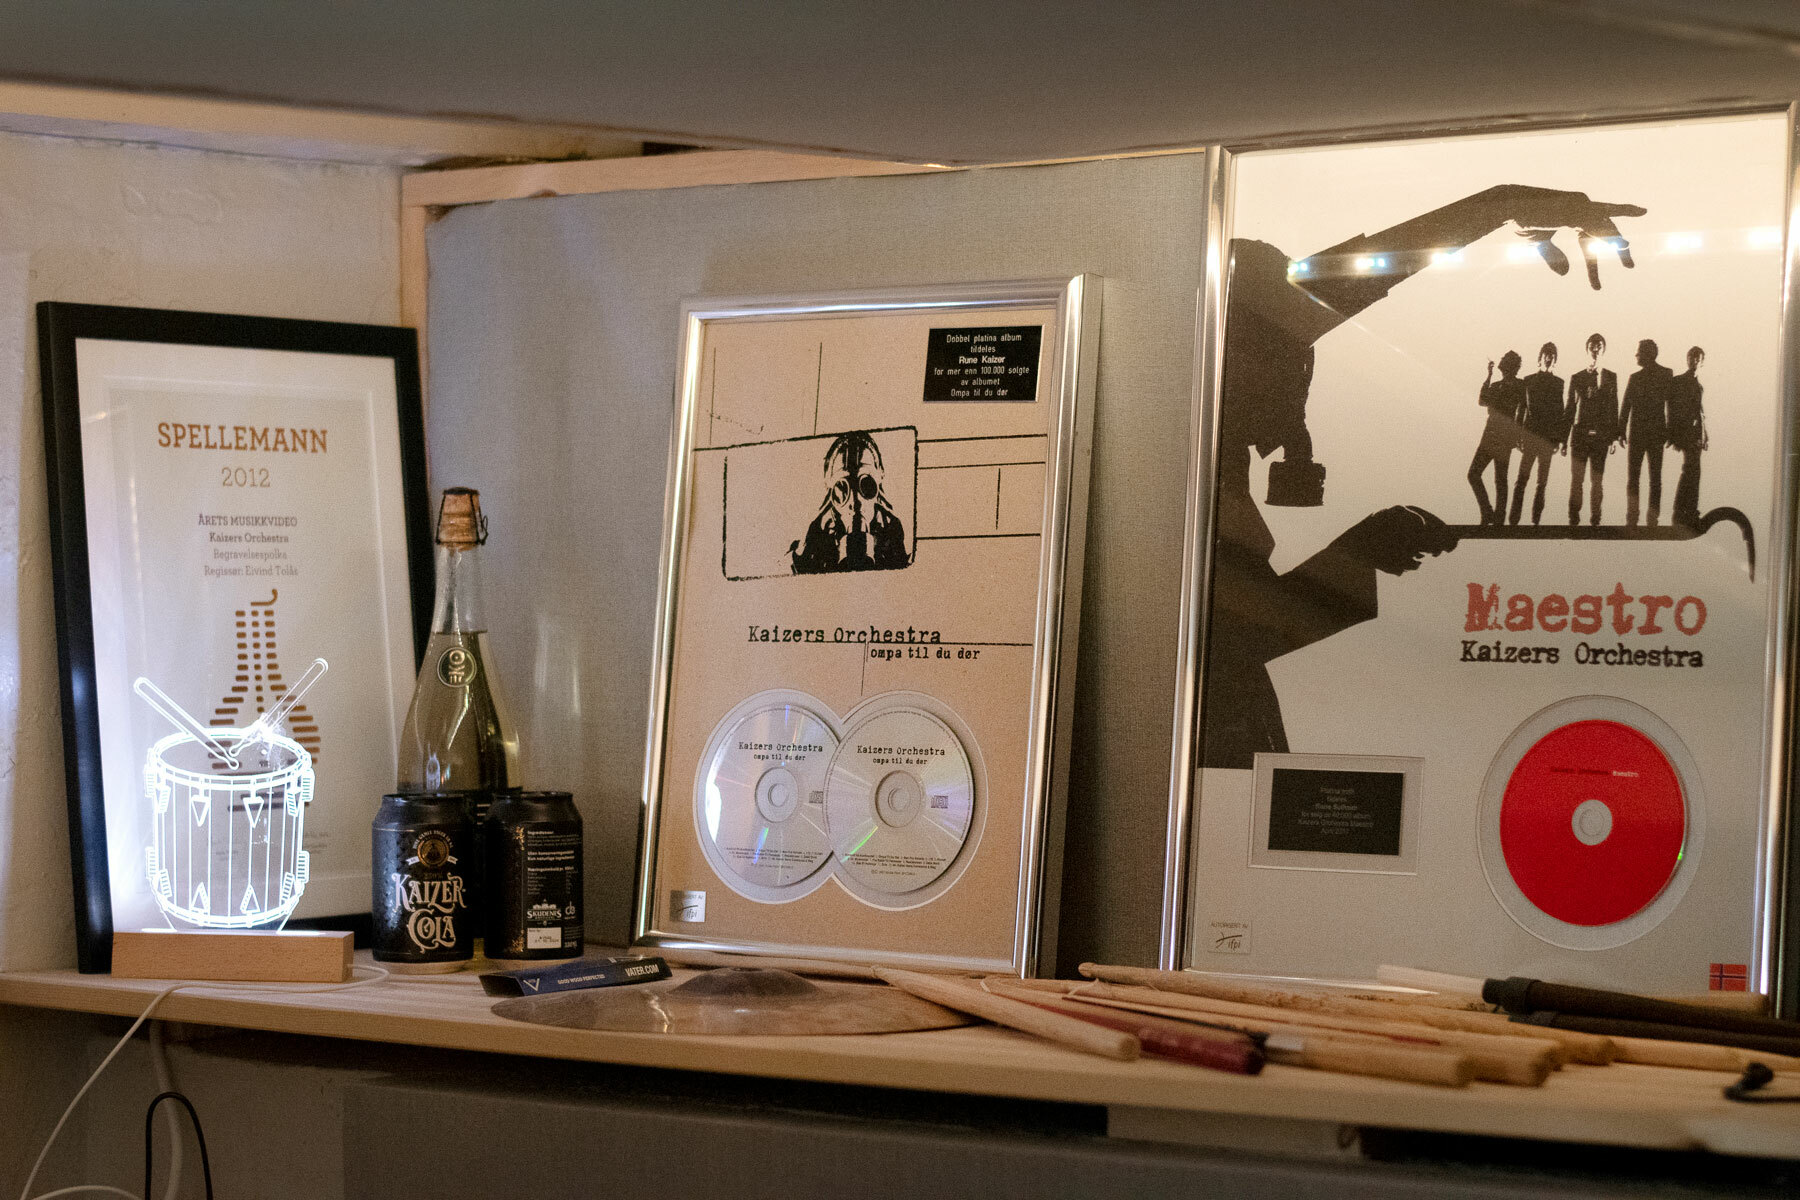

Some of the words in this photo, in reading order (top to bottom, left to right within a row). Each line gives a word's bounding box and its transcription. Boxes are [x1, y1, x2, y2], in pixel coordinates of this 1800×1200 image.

[946, 334, 970, 343] Dobbel
[973, 334, 997, 344] platina
[1000, 333, 1022, 342] album
[970, 345, 996, 353] tildeles
[958, 355, 978, 364] Rune
[981, 355, 1006, 364] Kaizer
[934, 368, 944, 376] for
[964, 367, 978, 375] enn
[981, 366, 1005, 375] 100.000
[1008, 366, 1030, 376] solgte
[972, 377, 1000, 386] albumet
[950, 389, 970, 398] Ompa
[973, 388, 981, 397] til
[984, 388, 993, 396] du
[157, 421, 328, 453] SPELLEMANN
[221, 466, 271, 488] 2012
[198, 513, 228, 527] ÅRETS
[230, 516, 298, 528] MUSIKKVIDEO
[209, 532, 242, 543] Kaizers
[244, 533, 289, 544] Orchestra
[245, 566, 273, 576] Eivind
[1463, 581, 1708, 637] Maestro
[747, 625, 825, 643] Kaizers
[833, 625, 942, 645] Orchestra
[870, 649, 902, 662] ompa
[908, 647, 929, 659] til
[936, 647, 951, 660] du
[957, 647, 981, 660] dør
[1459, 640, 1560, 664] Kaizers
[1574, 641, 1704, 668] Orchestra
[738, 741, 773, 751] Kaizers
[776, 742, 823, 752] Orchestra
[857, 745, 893, 754] Kaizers
[896, 746, 946, 756] Orchestra
[771, 753, 782, 761] til
[785, 753, 792, 761] du
[891, 757, 903, 765] til
[905, 757, 914, 765] du
[406, 908, 457, 954] COLA
[624, 963, 659, 978] VATER.COM
